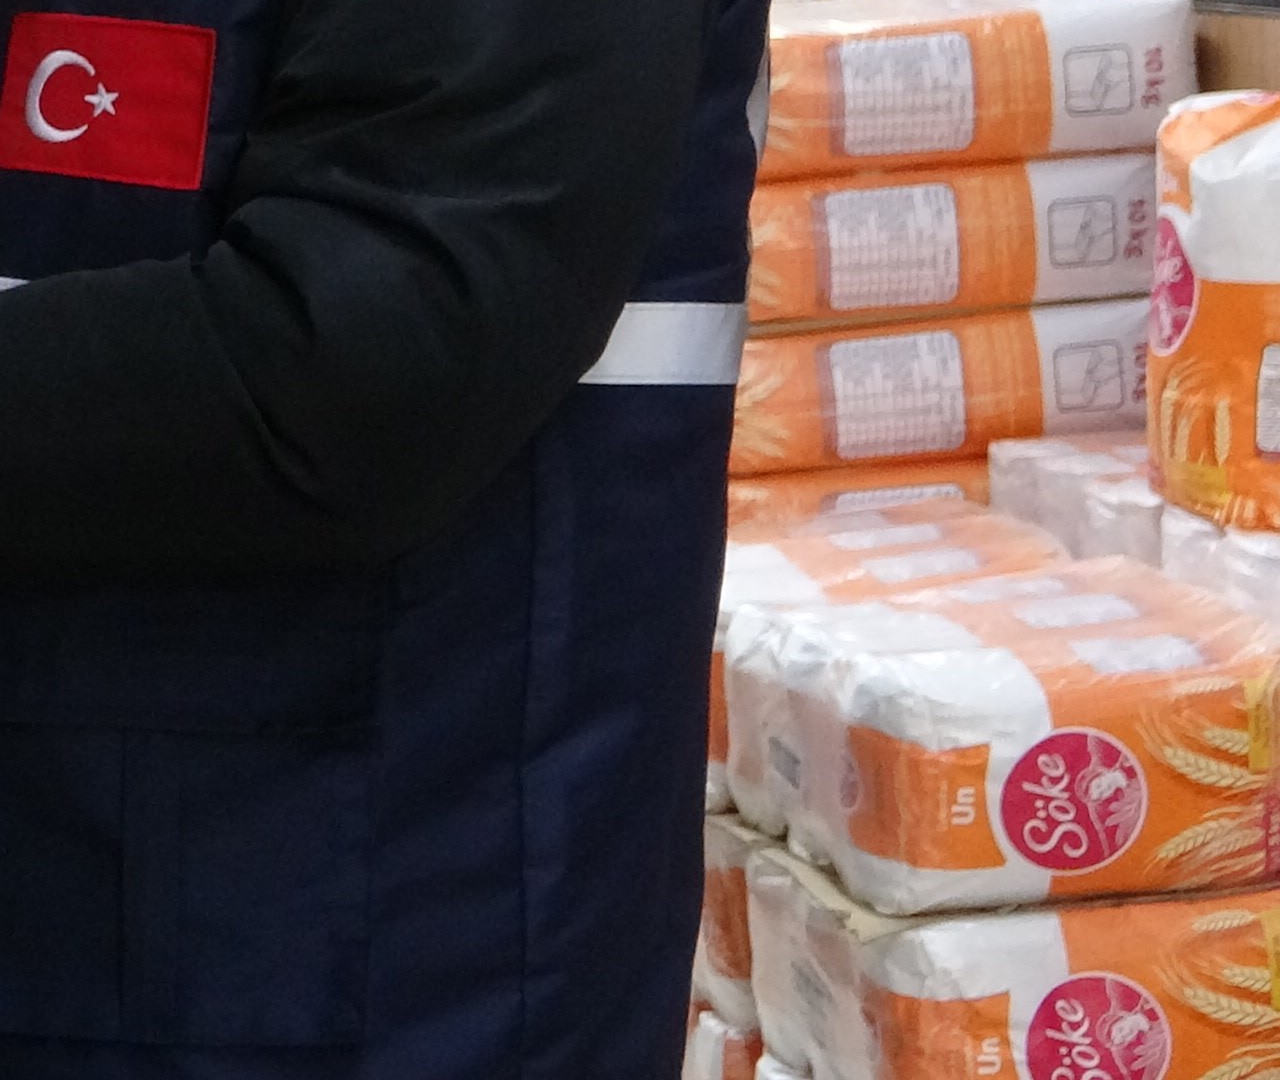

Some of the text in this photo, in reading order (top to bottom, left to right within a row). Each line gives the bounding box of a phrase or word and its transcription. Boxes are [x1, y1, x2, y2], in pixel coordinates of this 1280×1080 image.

[950, 785, 977, 826] Un
[1021, 753, 1089, 859] Söke
[976, 1036, 1003, 1076] Un
[1044, 998, 1110, 1080] öke
